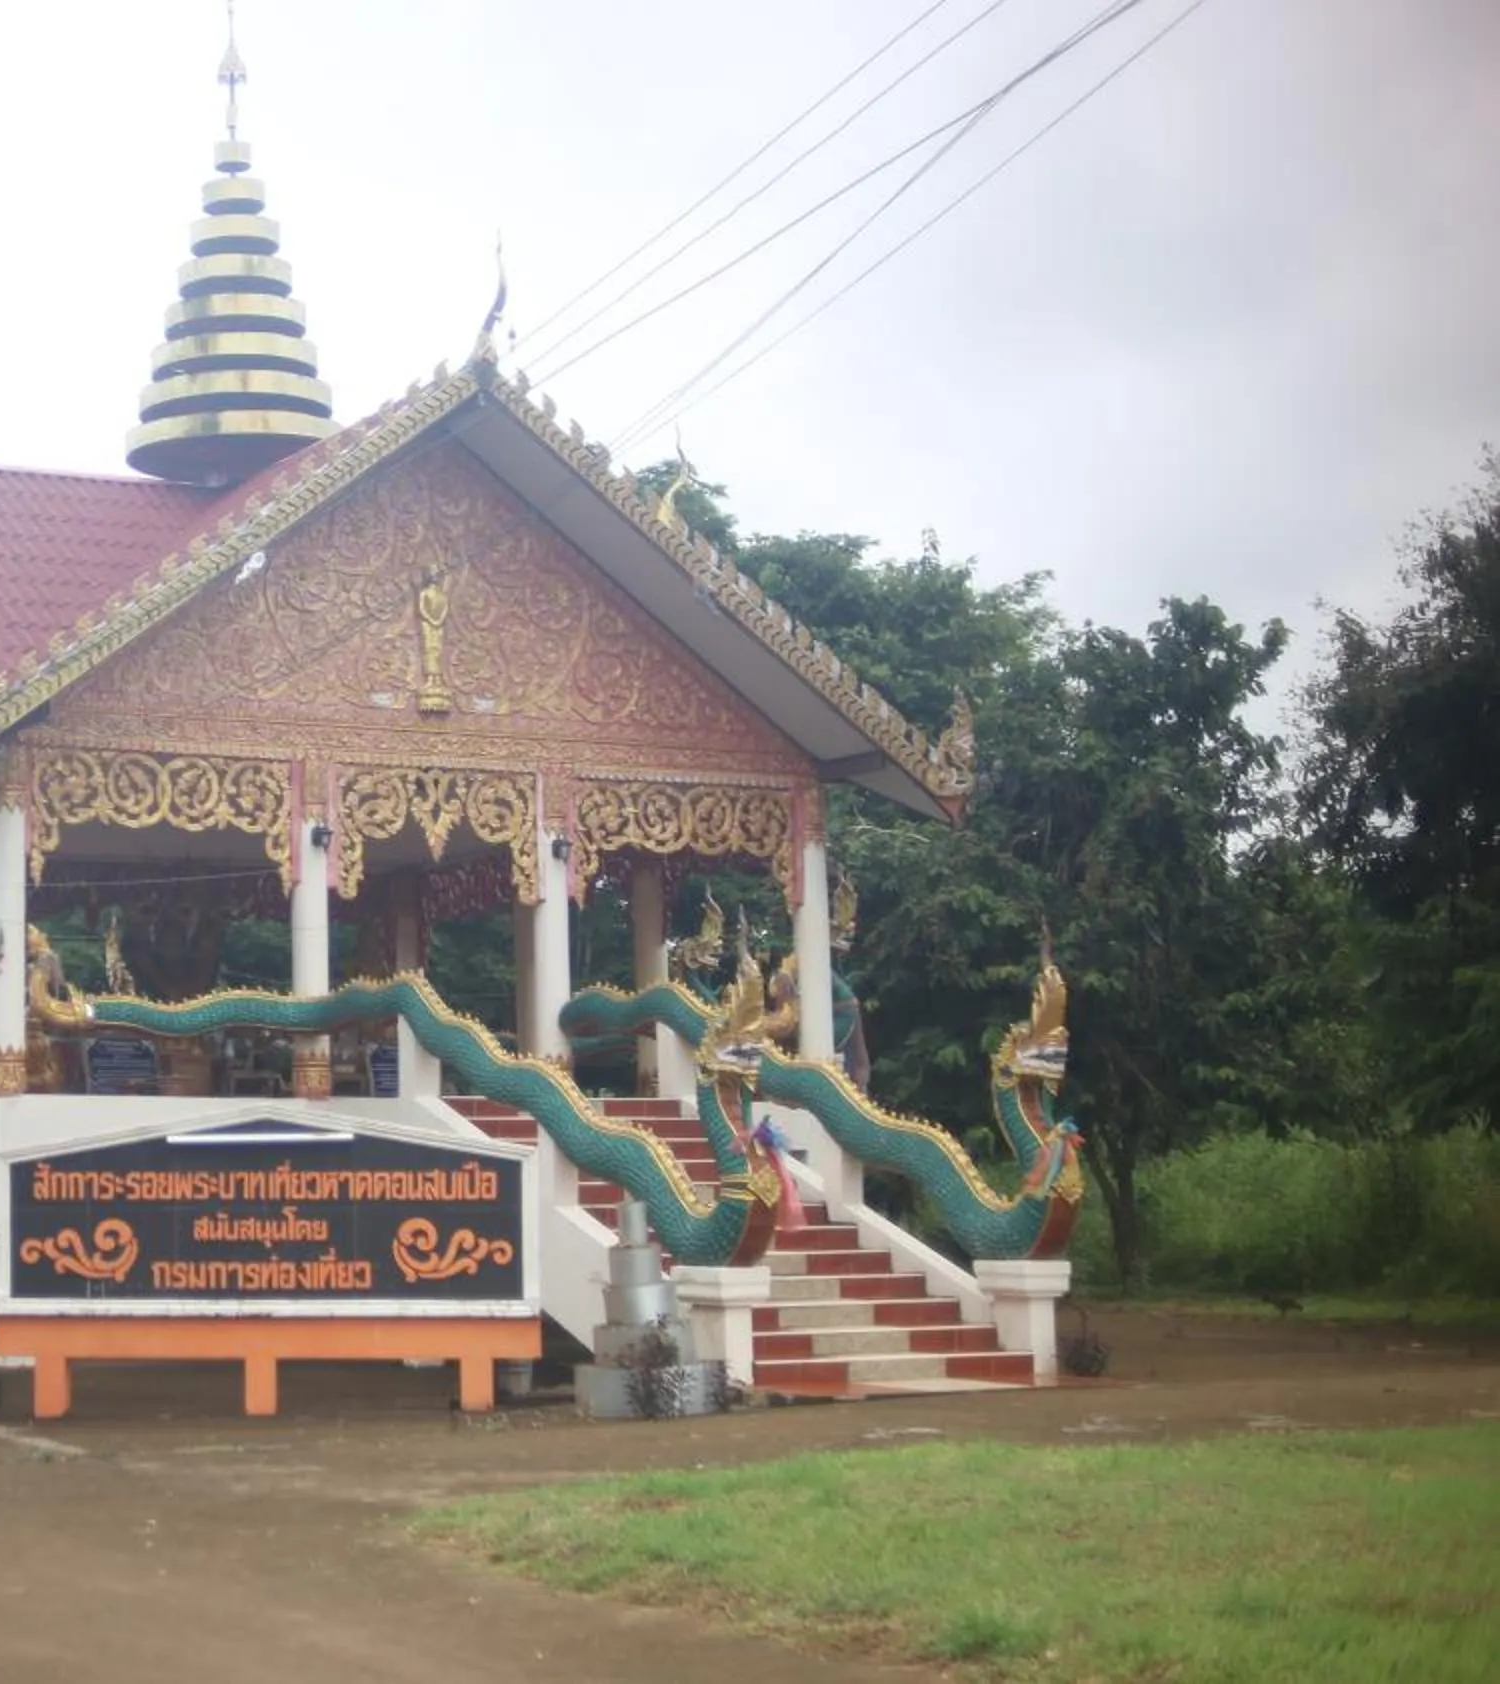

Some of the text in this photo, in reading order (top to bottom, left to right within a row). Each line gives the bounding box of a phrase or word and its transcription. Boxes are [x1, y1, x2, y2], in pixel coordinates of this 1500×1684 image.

[193, 1206, 328, 1248] สนับสนุนโดย
[152, 1249, 372, 1290] กรมการท่องเที่ยว
